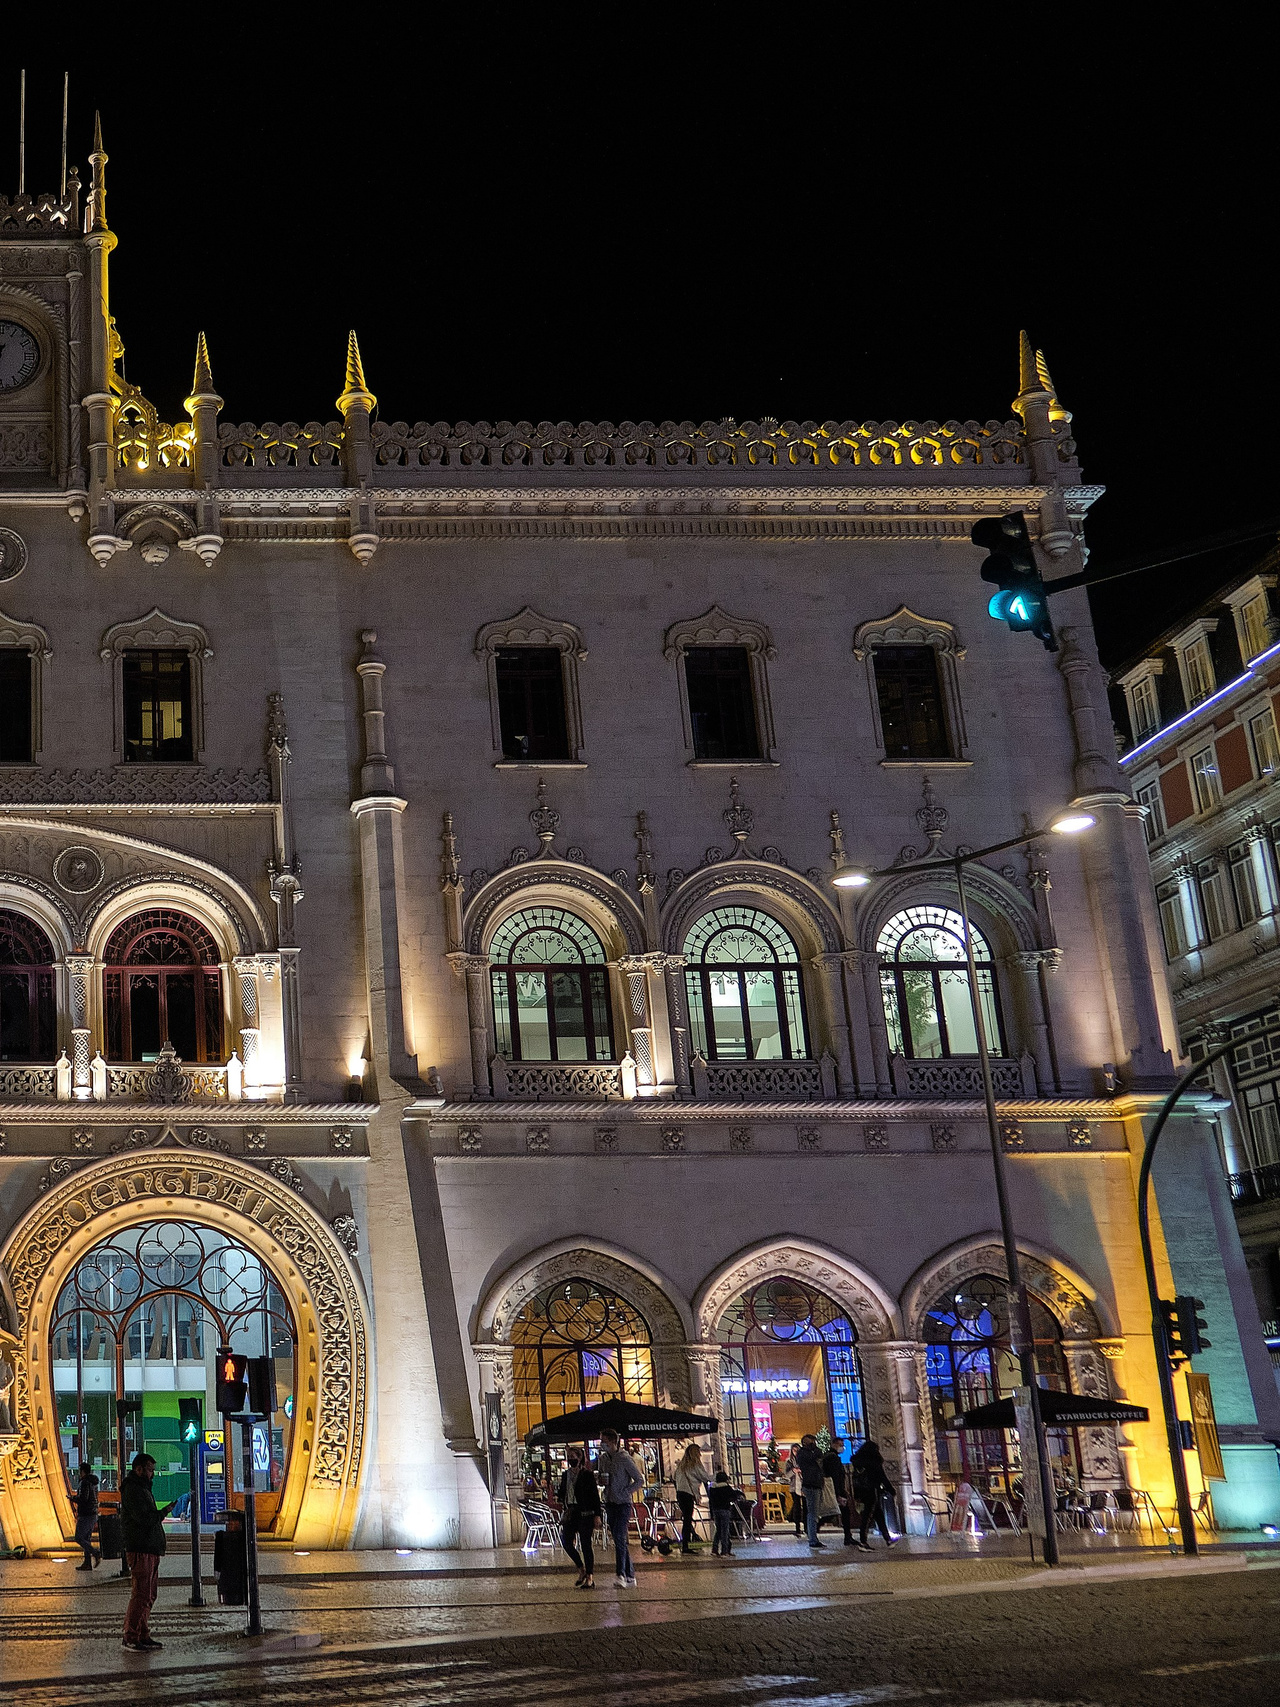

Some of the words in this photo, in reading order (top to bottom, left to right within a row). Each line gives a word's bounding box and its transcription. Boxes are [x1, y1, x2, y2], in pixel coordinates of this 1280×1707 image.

[1055, 1412, 1109, 1420] STARBUCKS
[1110, 1411, 1144, 1419] COFFEE
[628, 1423, 678, 1431] STARBUCKS
